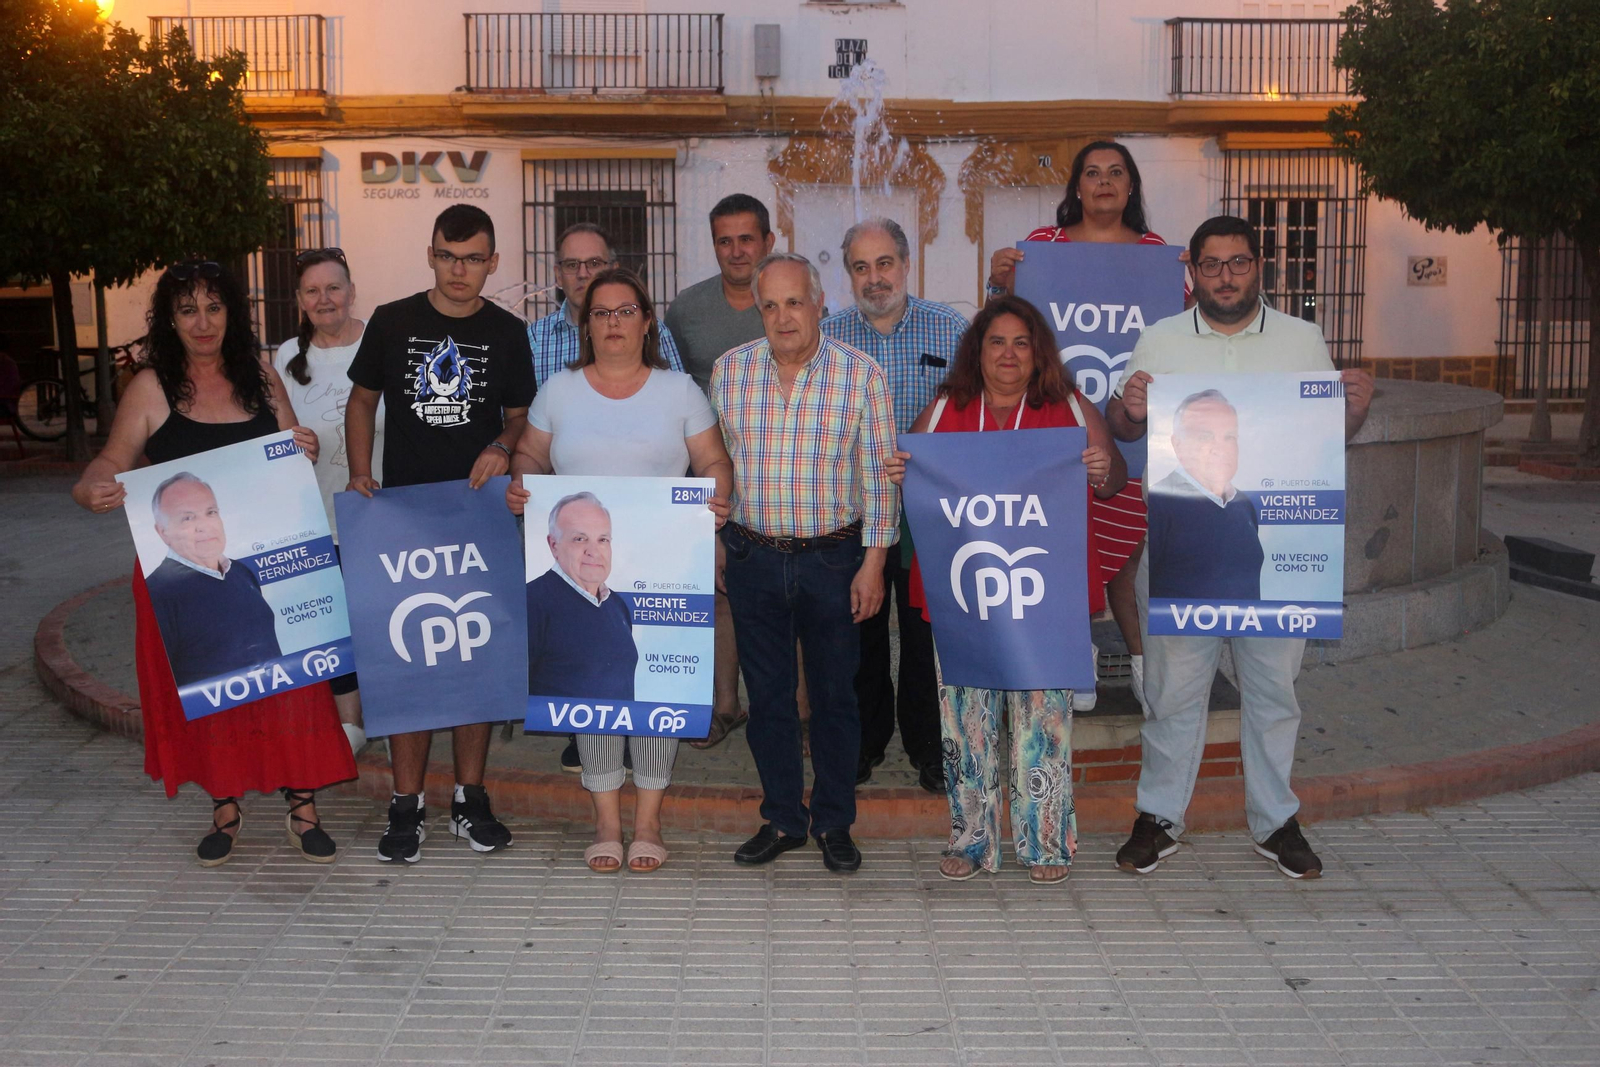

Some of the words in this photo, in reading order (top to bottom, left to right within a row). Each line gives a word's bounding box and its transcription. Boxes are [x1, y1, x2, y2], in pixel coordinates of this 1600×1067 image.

[835, 40, 868, 52] PLAZA
[837, 53, 850, 65] DE
[361, 151, 489, 184] DKV
[1039, 156, 1052, 168] 70
[363, 188, 420, 199] SEGUROS
[434, 184, 490, 199] MÉDICOS
[1049, 302, 1146, 334] VOTA
[1303, 384, 1331, 396] 28M
[267, 442, 295, 458] 28M
[674, 489, 702, 501] 28M
[1260, 495, 1316, 507] VICENTE
[939, 494, 1049, 528] VOTA
[1260, 507, 1339, 520] FERNÁNDEZ
[270, 533, 298, 546] PUERTO
[299, 529, 317, 539] REAL
[255, 546, 308, 569] VICENTE
[379, 543, 489, 583] VOTA
[1271, 553, 1286, 562] UN
[1289, 553, 1329, 562] VECINO
[258, 553, 333, 581] FERNÁNDEZ
[1275, 563, 1308, 572] COMO
[1311, 564, 1325, 572] TU
[280, 605, 295, 616] UN
[296, 595, 333, 612] VECINO
[633, 597, 687, 609] VICENTE
[286, 610, 317, 625] COMO
[319, 605, 333, 616] TU
[633, 609, 709, 623] FERNÁNDEZ
[1170, 604, 1263, 632] VOTA
[645, 653, 659, 662] UN
[662, 654, 699, 664] VECINO
[648, 664, 680, 674] COMO
[683, 666, 696, 675] TU
[200, 663, 294, 708] VOTA
[547, 702, 634, 731] VOTA
